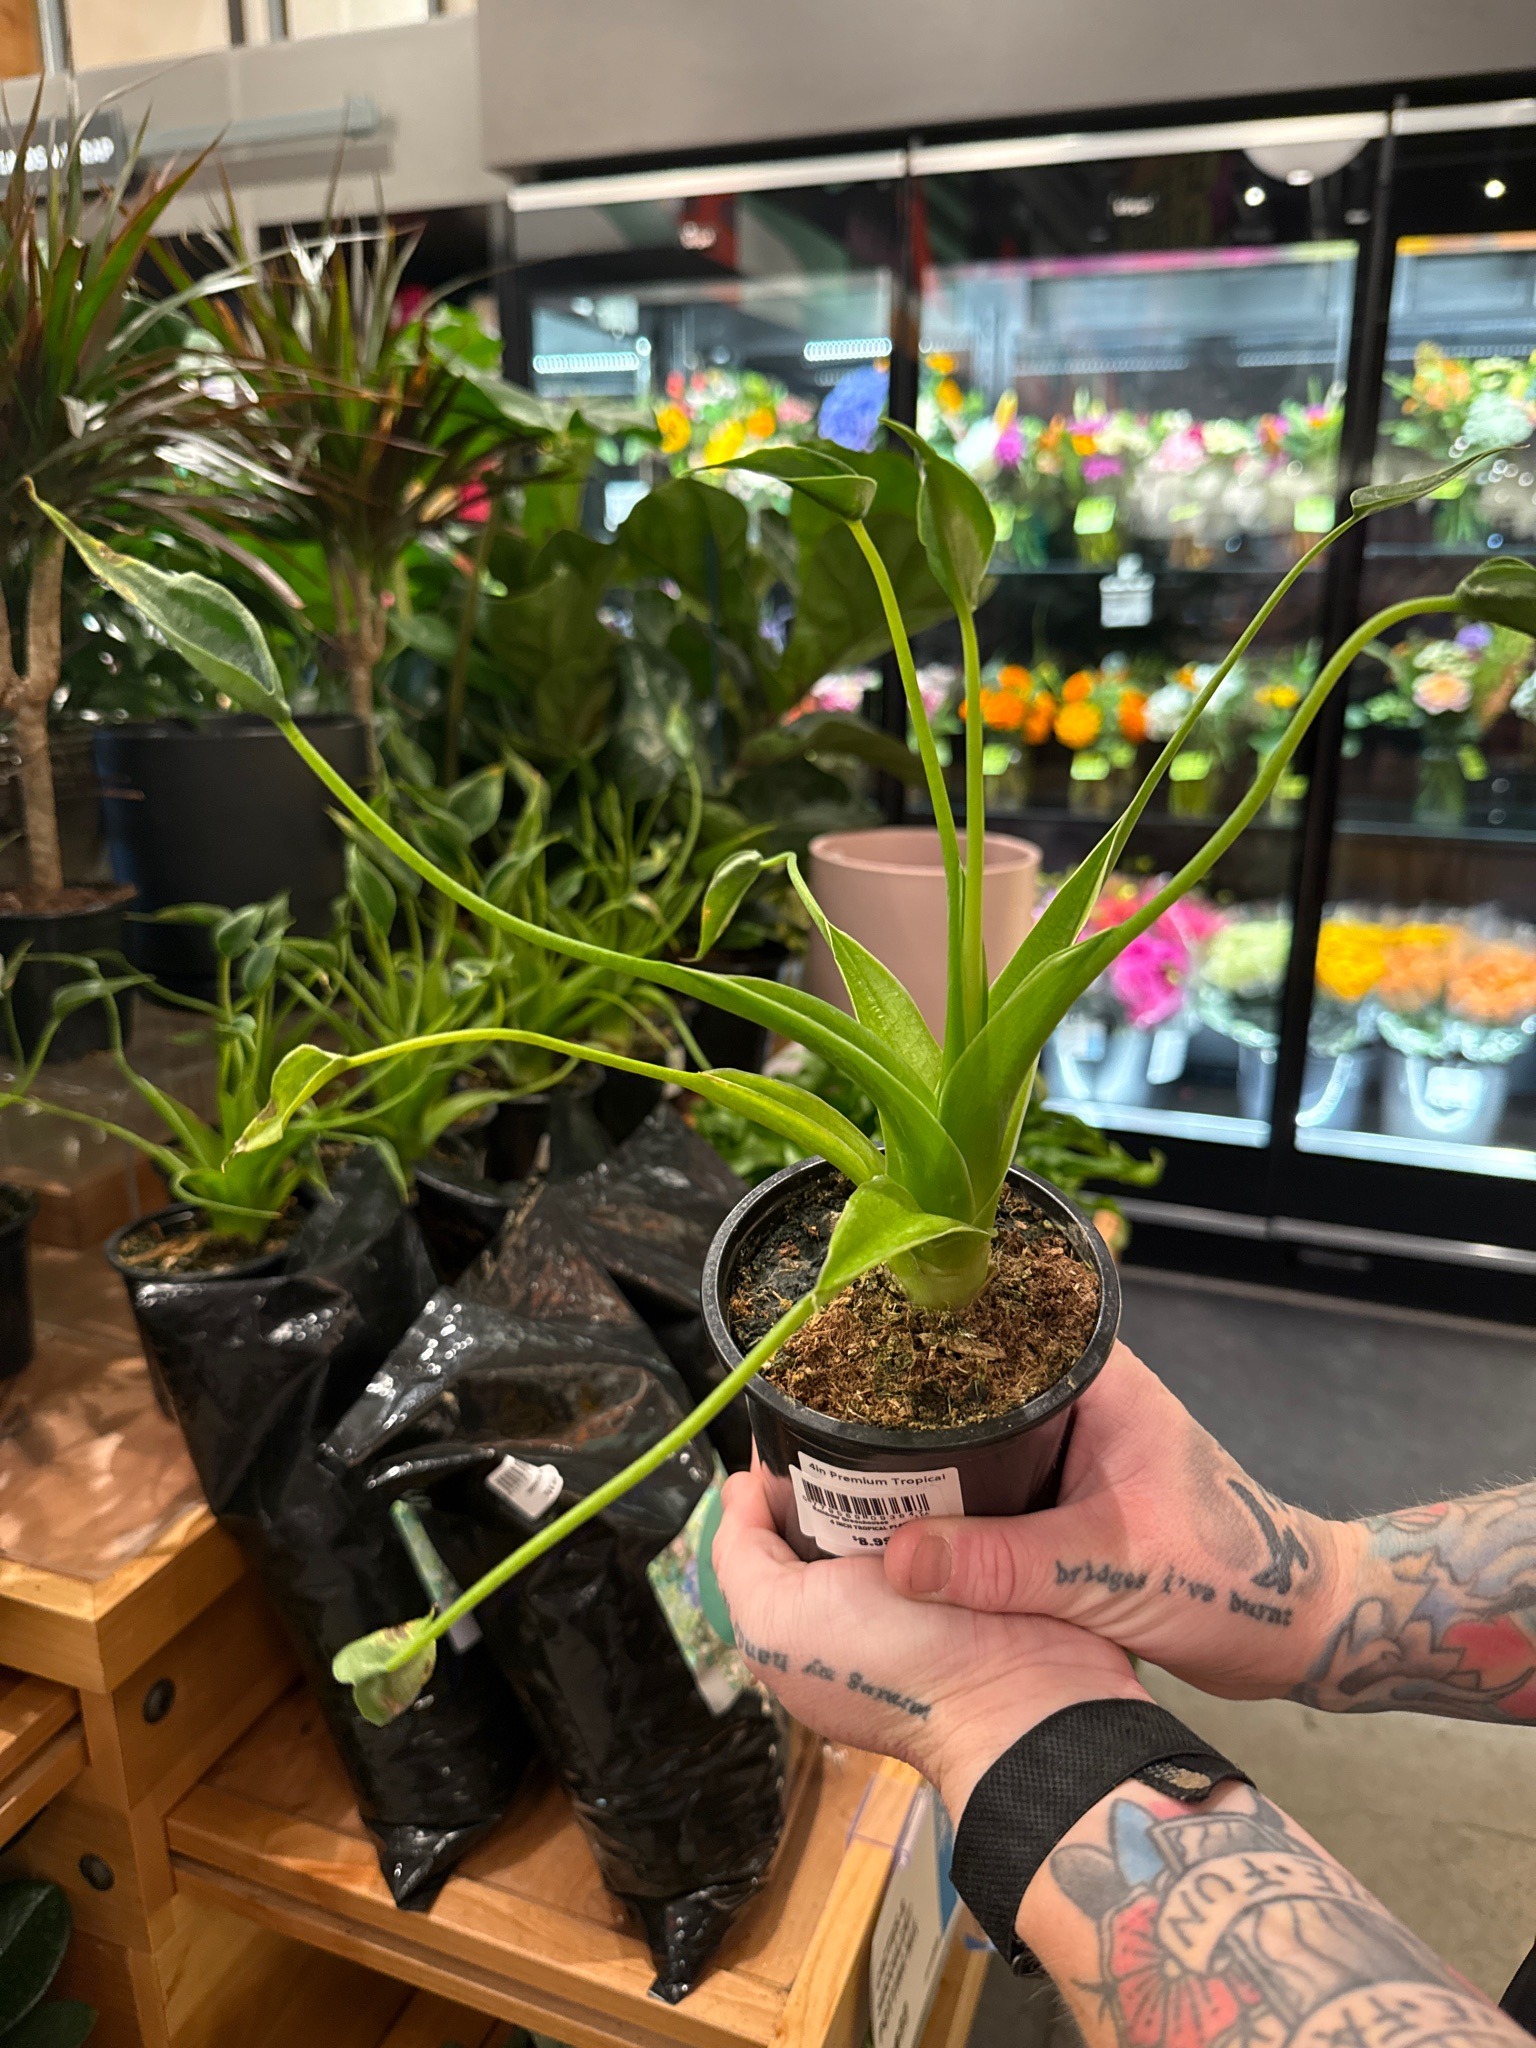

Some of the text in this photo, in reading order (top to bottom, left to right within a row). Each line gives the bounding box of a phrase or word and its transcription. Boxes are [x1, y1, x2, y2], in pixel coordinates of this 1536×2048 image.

[808, 1463, 946, 1487] 4in Premium Tropical
[836, 1521, 853, 1529] INCH
[1055, 1559, 1293, 1627] bridges i've burnt
